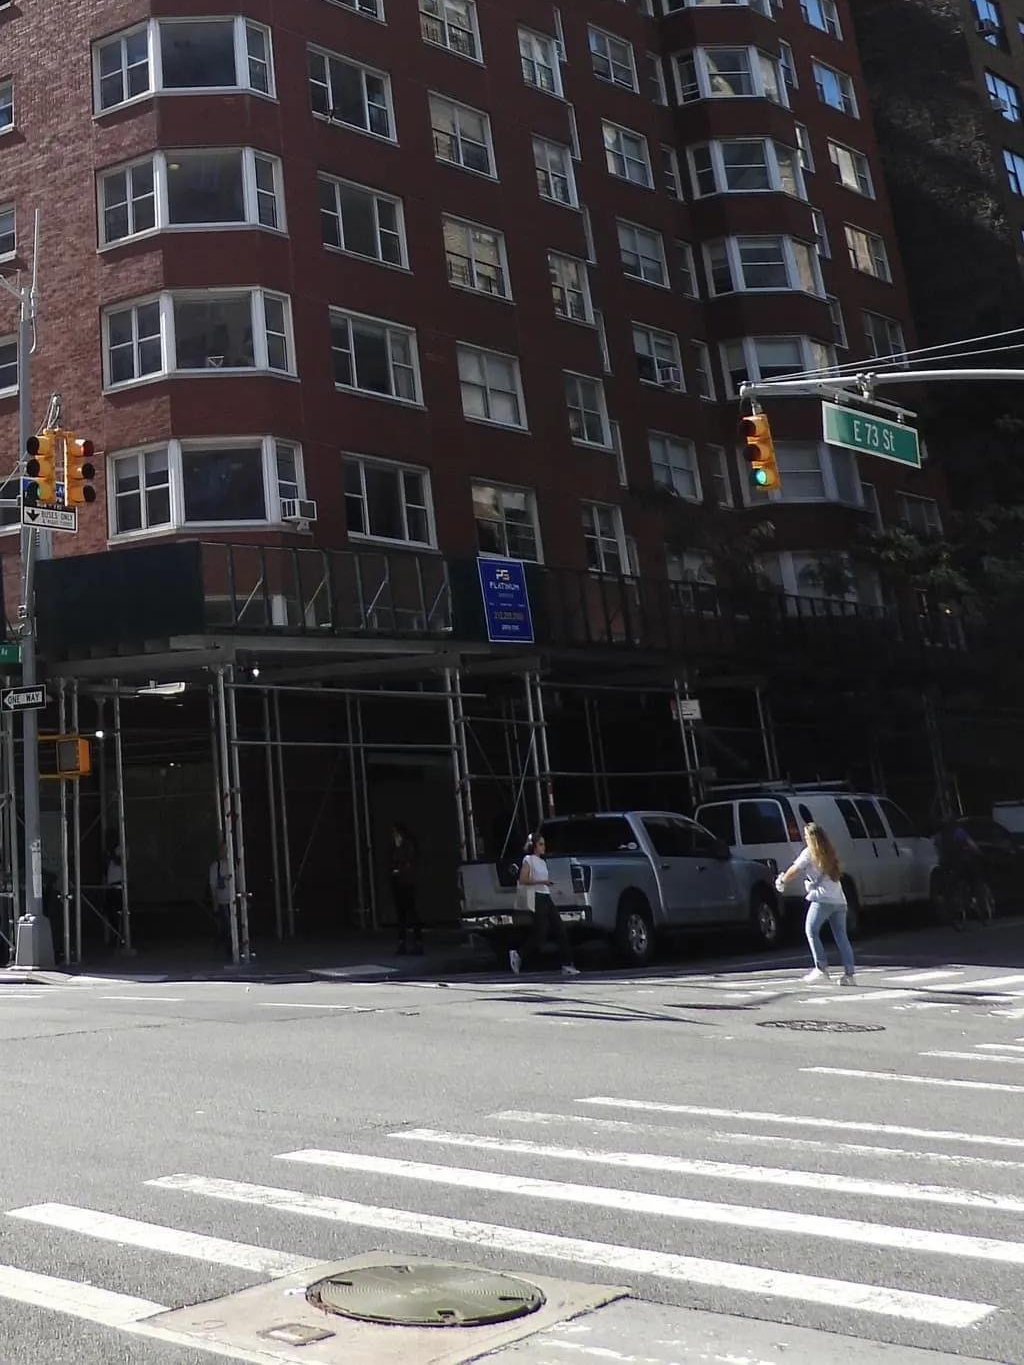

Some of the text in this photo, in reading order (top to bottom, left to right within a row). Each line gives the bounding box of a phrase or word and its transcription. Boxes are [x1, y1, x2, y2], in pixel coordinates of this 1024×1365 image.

[853, 420, 895, 452] E 73 St
[7, 692, 40, 705] ONE WAY
